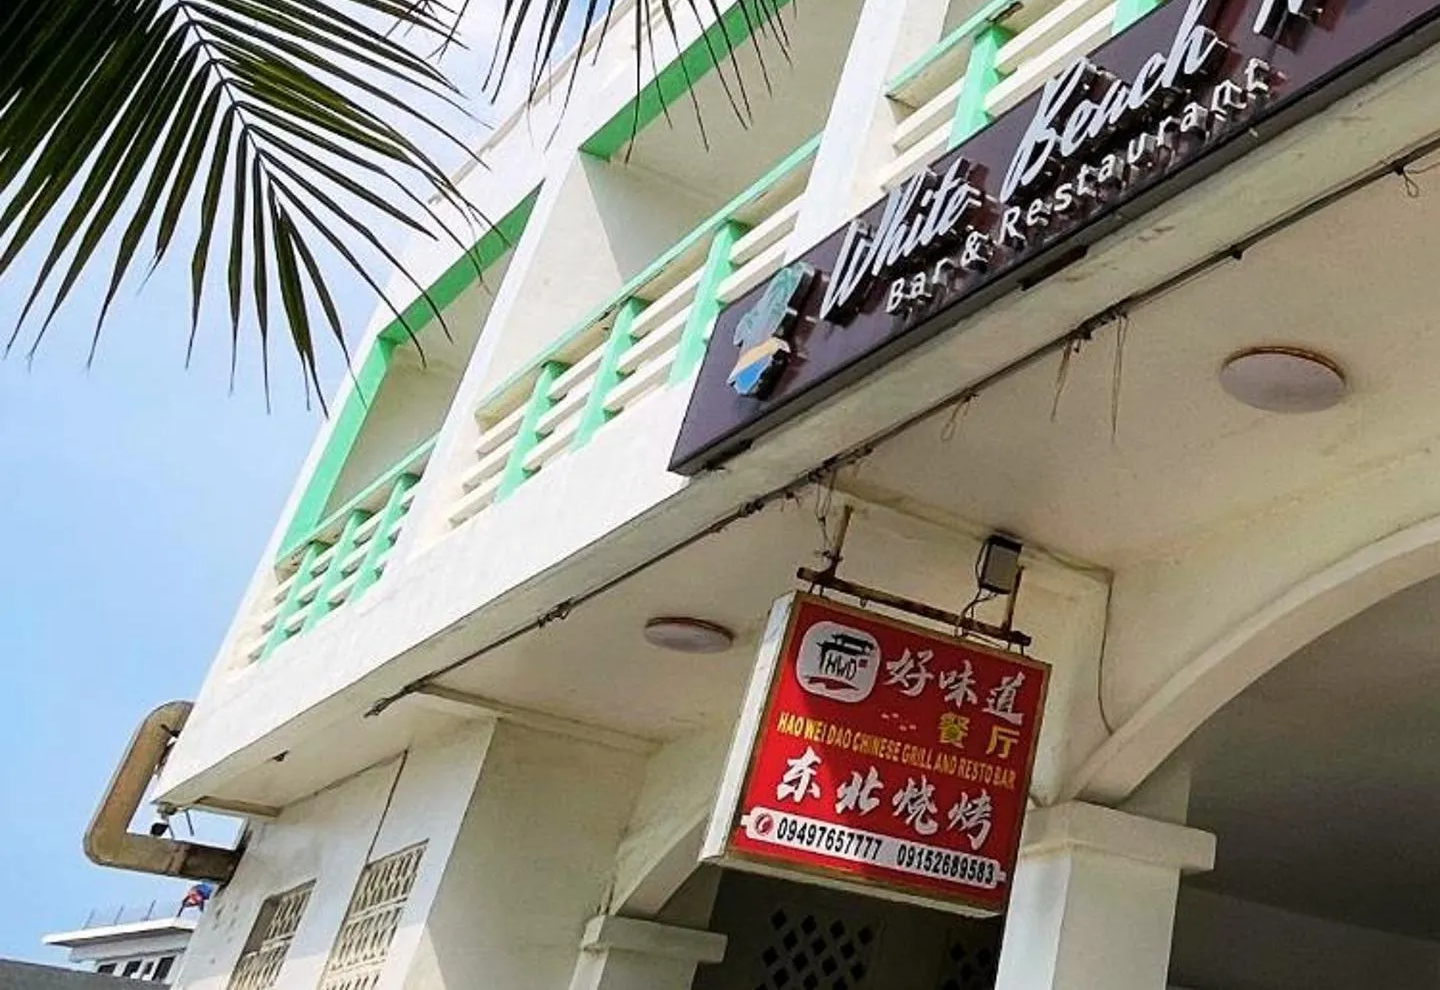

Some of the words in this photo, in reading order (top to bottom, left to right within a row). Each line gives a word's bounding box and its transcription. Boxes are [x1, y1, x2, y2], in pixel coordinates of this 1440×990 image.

[886, 257, 954, 312] Bar
[960, 230, 989, 268] &
[999, 57, 1270, 246] Restaurant
[819, 157, 972, 320] White
[885, 648, 1026, 726] 好味道
[777, 711, 804, 737] HAO
[803, 718, 828, 743] WEI
[826, 724, 852, 749] DAO
[852, 731, 902, 762] CHINESE
[901, 743, 933, 770] GRILL
[932, 751, 957, 775] AND
[938, 712, 1021, 760] 餐厅
[775, 745, 994, 851] 东北烧烤
[776, 816, 883, 861] 09497657777
[896, 844, 995, 885] 09152689583
